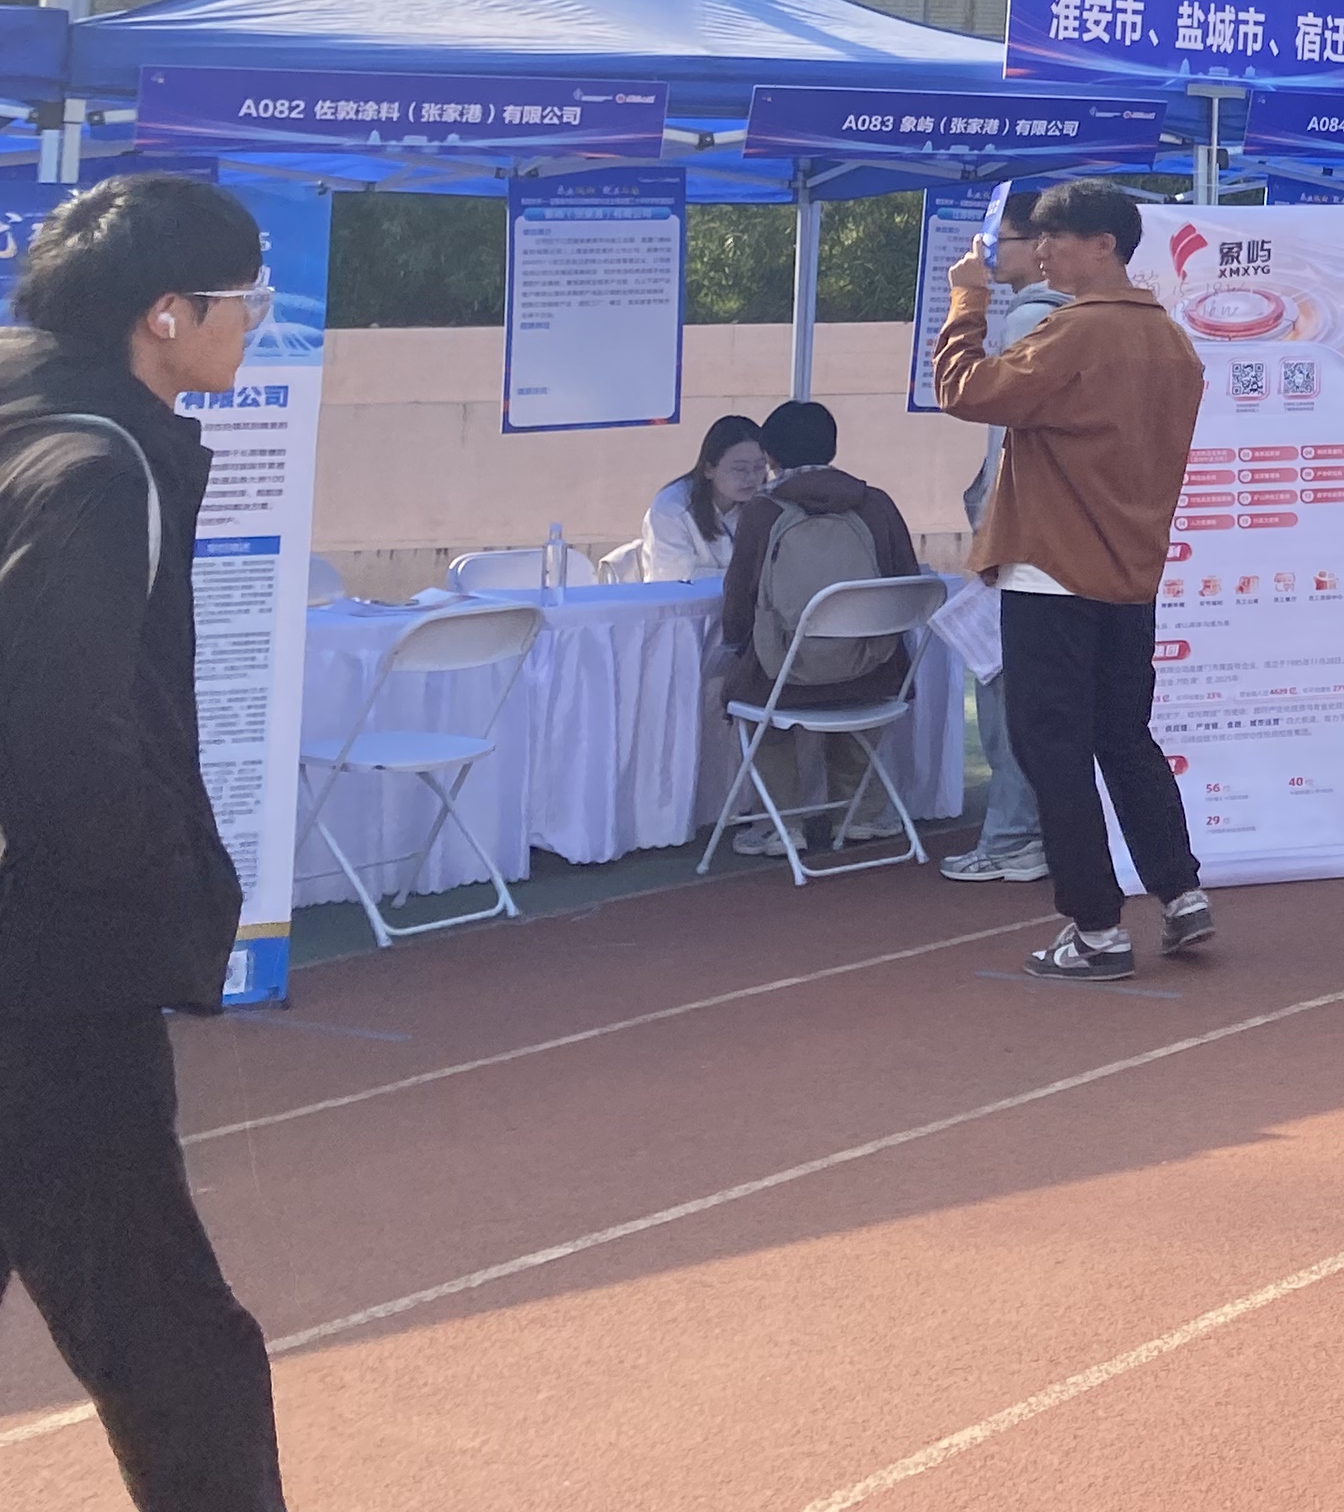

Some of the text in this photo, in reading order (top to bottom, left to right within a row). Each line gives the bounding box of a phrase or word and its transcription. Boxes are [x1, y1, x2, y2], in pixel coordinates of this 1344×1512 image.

[238, 99, 305, 119] A082
[842, 113, 893, 132] A083
[1218, 239, 1272, 266] 象屿
[1217, 264, 1271, 279] XMXYG
[1206, 783, 1220, 793] 56
[1288, 777, 1303, 787] 40
[1206, 815, 1220, 825] 29
